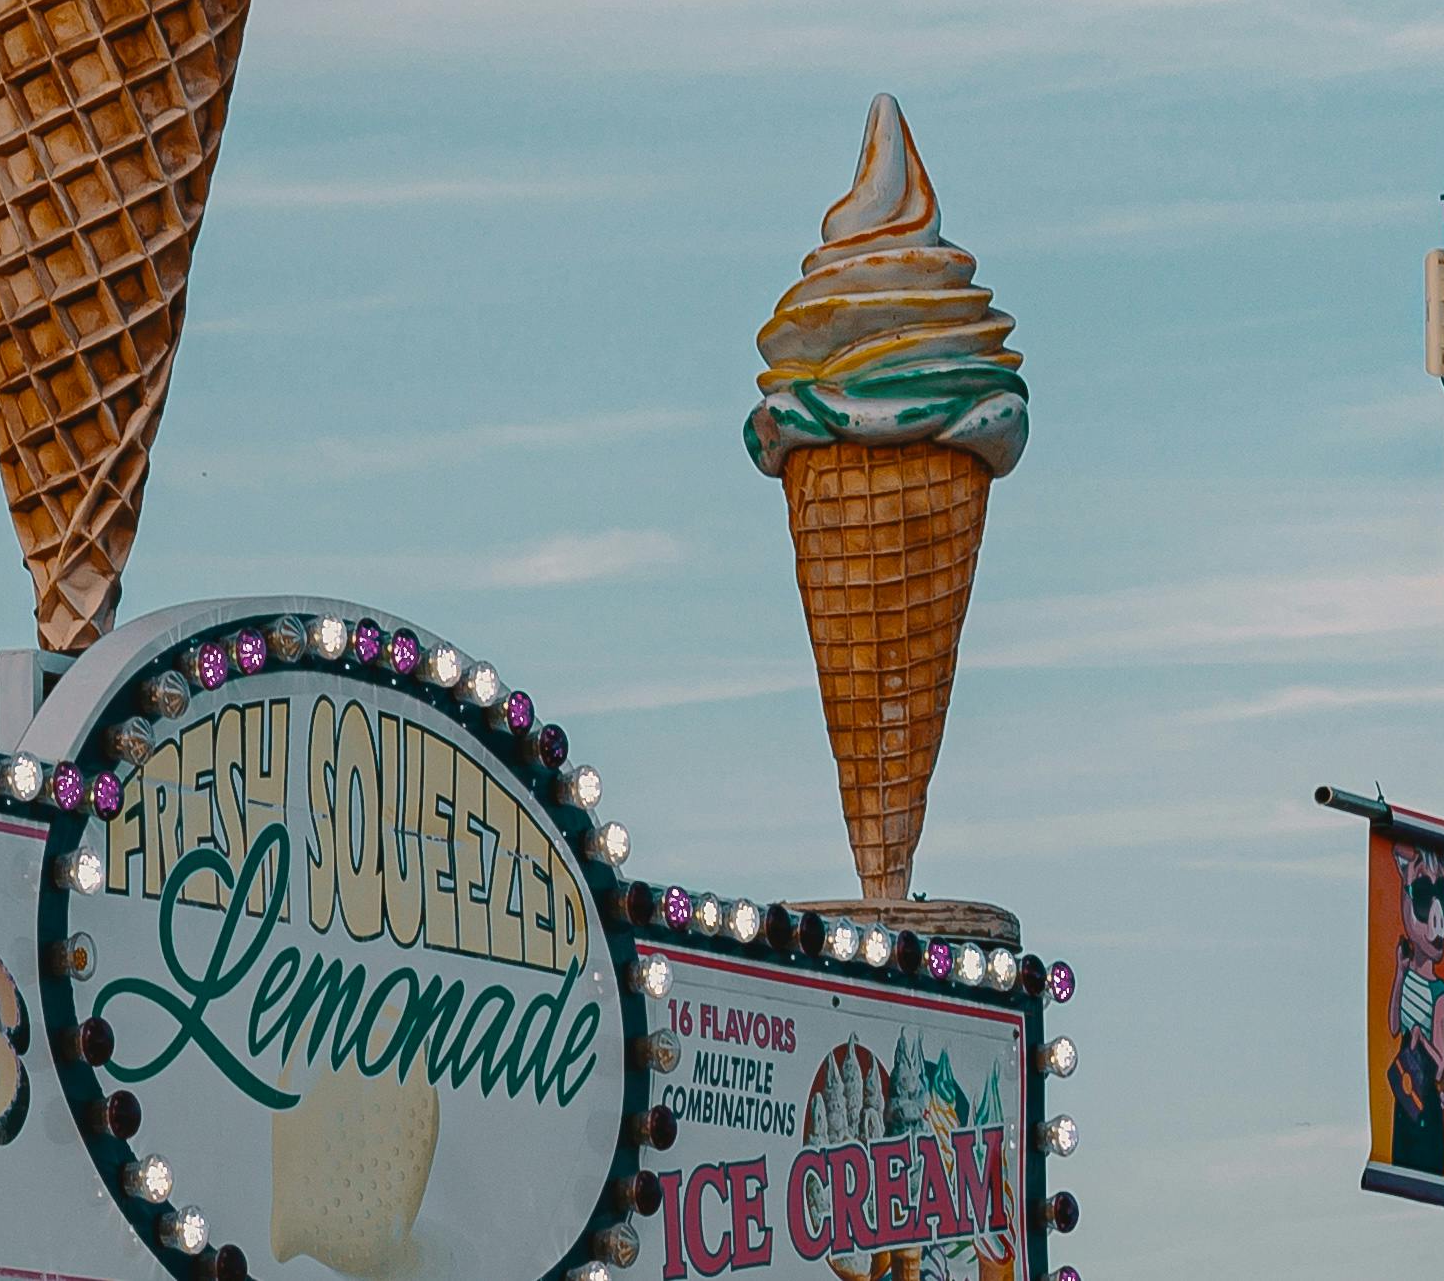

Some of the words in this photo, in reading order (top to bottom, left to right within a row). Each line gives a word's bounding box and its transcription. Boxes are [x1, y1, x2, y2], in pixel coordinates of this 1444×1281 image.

[106, 697, 291, 924] FRESH
[307, 694, 588, 978] SQUEEZED
[92, 822, 600, 1110] Lemonade
[667, 999, 694, 1036] 16
[700, 1003, 796, 1054] FLAVORS
[692, 1050, 774, 1095] MULTIPLE
[661, 1085, 796, 1138] COMBINATIONS
[658, 1154, 773, 1280] ICE
[786, 1125, 1012, 1262] CREAM
